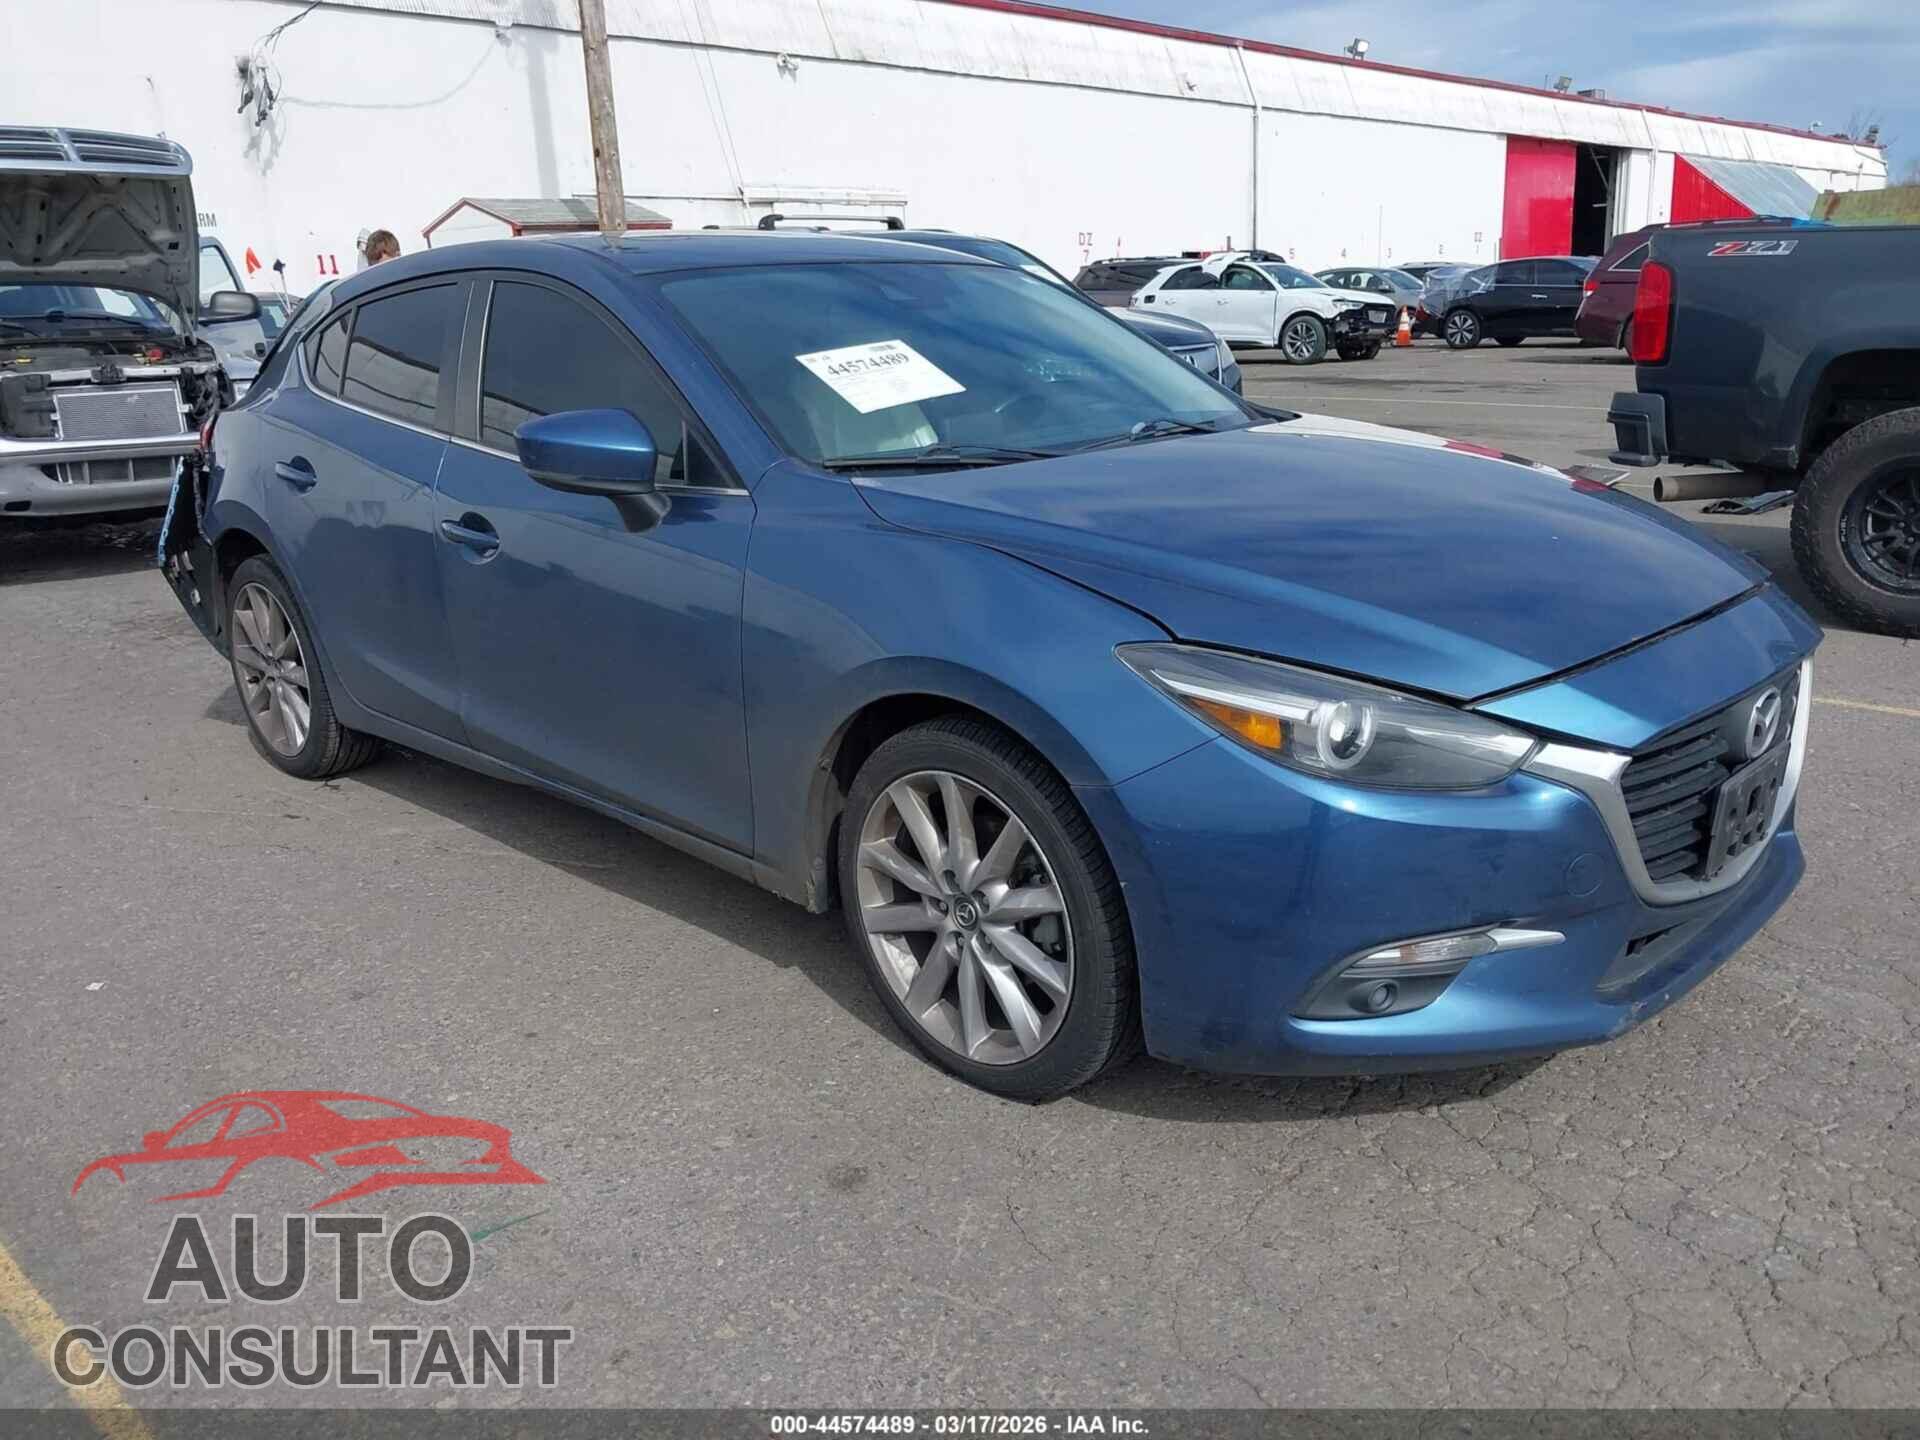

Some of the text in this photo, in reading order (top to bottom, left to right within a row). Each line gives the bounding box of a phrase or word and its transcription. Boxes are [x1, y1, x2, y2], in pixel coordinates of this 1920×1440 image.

[1707, 240, 1799, 256] Z71
[317, 254, 339, 275] 11
[827, 352, 910, 376] 44574489
